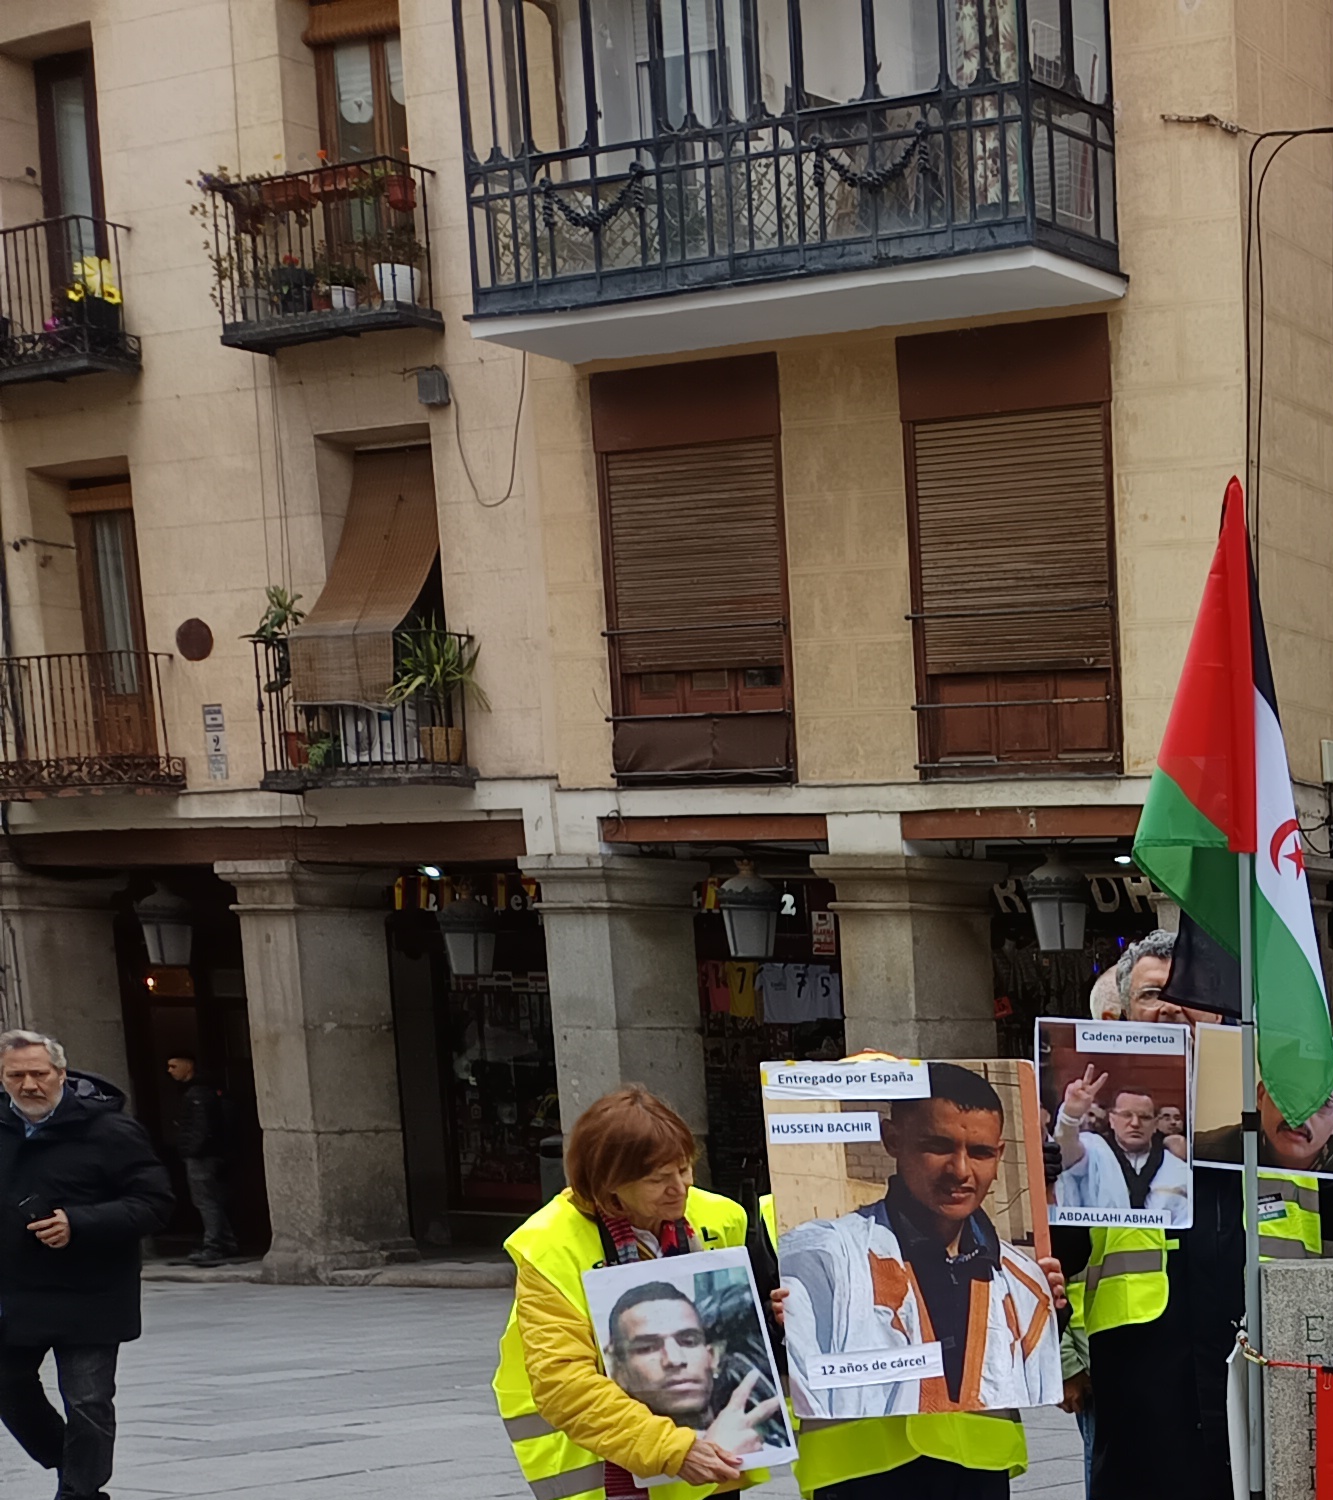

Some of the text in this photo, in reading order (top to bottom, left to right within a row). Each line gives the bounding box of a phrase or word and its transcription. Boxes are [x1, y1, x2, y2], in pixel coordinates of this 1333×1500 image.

[213, 735, 220, 751] 2
[781, 894, 796, 916] 2
[821, 977, 830, 997] 5
[1081, 1031, 1176, 1046] Cadena perpetua
[778, 1071, 915, 1085] Entregado por España
[771, 1121, 873, 1134] HUSSEIN BACHIR
[1058, 1210, 1164, 1225] ABDALLAHI ABHAH
[820, 1356, 926, 1376] 12 años de cárcel
